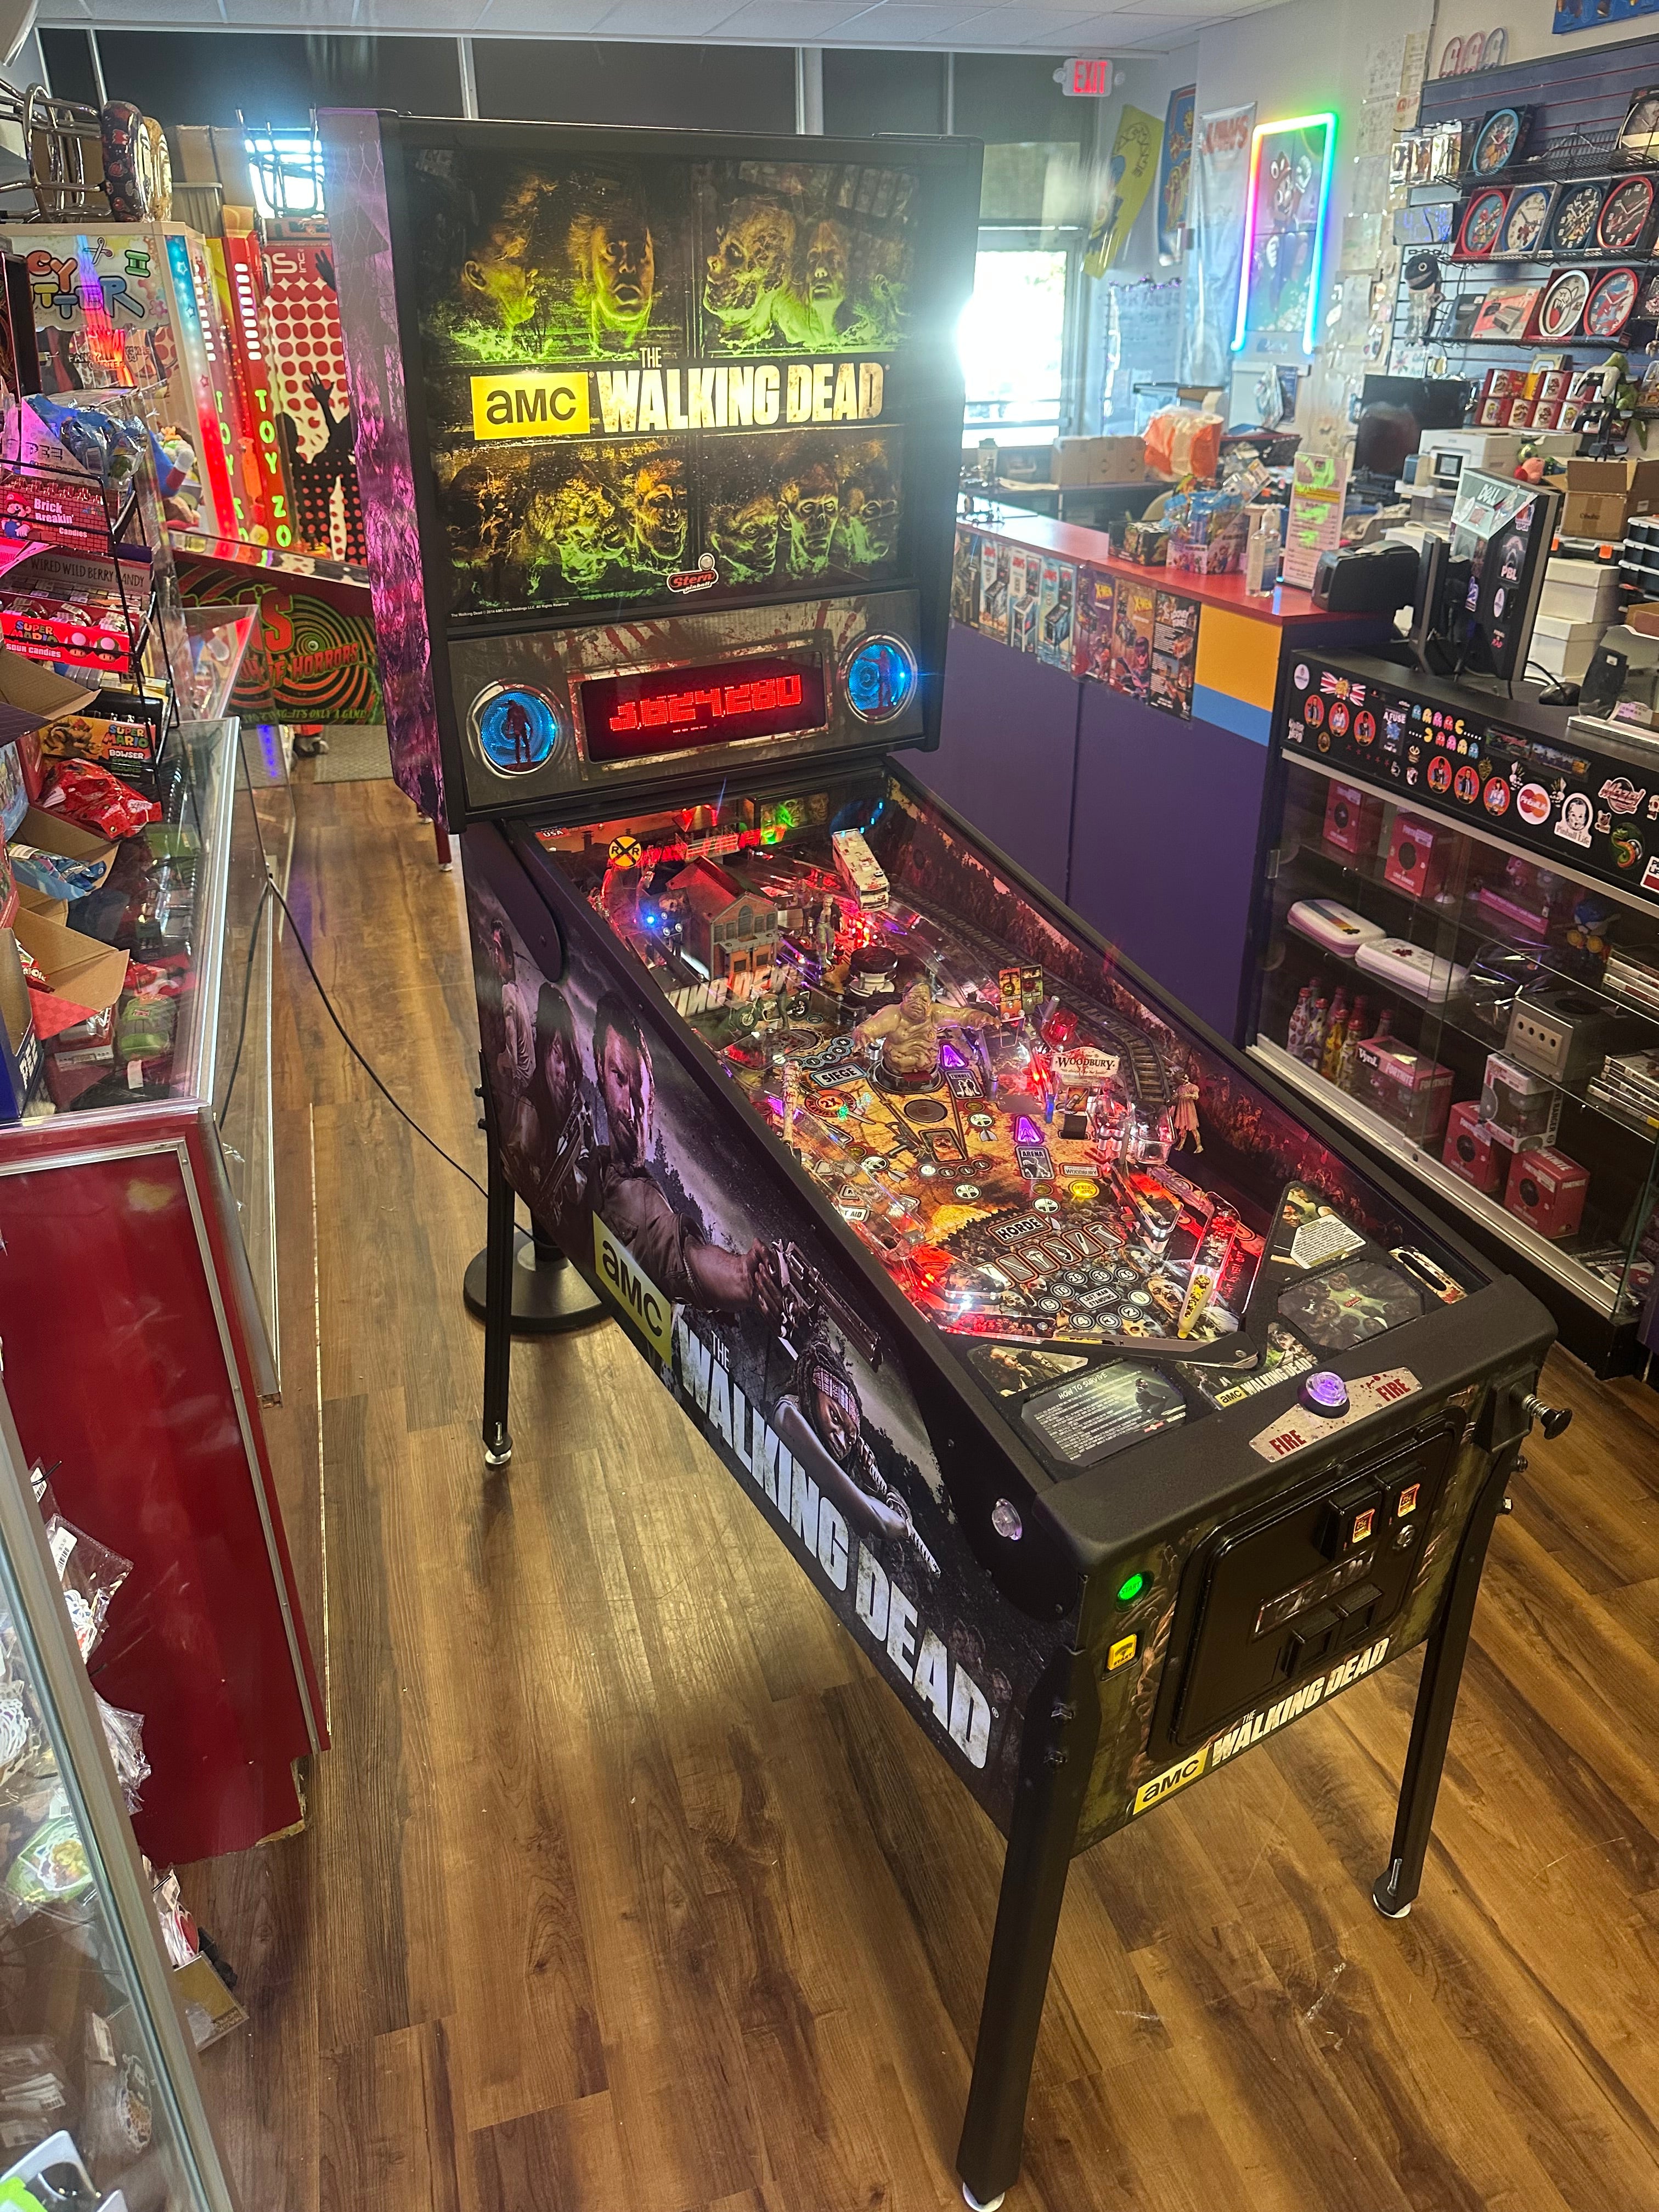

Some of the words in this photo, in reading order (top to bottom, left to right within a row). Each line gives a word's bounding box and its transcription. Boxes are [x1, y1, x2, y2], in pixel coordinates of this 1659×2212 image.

[1074, 60, 1108, 94] EXIT
[639, 346, 662, 369] THE
[596, 364, 781, 434] WALKING
[786, 362, 884, 424] DEAD
[1476, 483, 1500, 506] DELL
[34, 498, 63, 514] Brick
[35, 512, 74, 524] Breakin'
[59, 527, 88, 538] Candies
[31, 557, 60, 573] WIRED
[63, 563, 86, 577] WILD
[88, 568, 114, 582] BERRY
[1501, 565, 1517, 581] PBL
[673, 573, 712, 588] Stern
[685, 582, 710, 591] pinball
[16, 620, 53, 635] SUPER
[10, 629, 58, 647] MARIO
[6, 643, 27, 653] SOUR
[291, 642, 360, 680] HORRORS
[1389, 712, 1406, 725] FUSE
[109, 724, 145, 737] SUPER
[102, 733, 149, 748] MARIO
[109, 749, 145, 760] BOWSER
[1556, 825, 1577, 840] Pinball
[1578, 831, 1590, 845] Life
[611, 846, 619, 855] R
[632, 847, 640, 855] R
[1058, 1057, 1113, 1070] WOODBURY
[821, 1068, 857, 1083] SIEGE
[1386, 1063, 1414, 1087] FORTNITE
[820, 1098, 842, 1108] 2X
[995, 1217, 1043, 1241] HORDE
[1068, 1273, 1083, 1283] 20
[1094, 1271, 1108, 1280] 30
[1120, 1269, 1133, 1279] 40
[1054, 1286, 1070, 1295] 10
[1082, 1293, 1096, 1302] LAST
[1096, 1289, 1109, 1297] MAN
[1046, 1300, 1056, 1309] 5
[1089, 1294, 1115, 1307] STANDING
[1123, 1307, 1138, 1317] 2
[1077, 1316, 1089, 1326] 4
[1103, 1316, 1115, 1325] 3
[712, 1330, 730, 1372] THE
[1240, 1365, 1289, 1396] WALKING
[1287, 1357, 1313, 1380] DEAD
[1058, 1388, 1074, 1400] HOW
[1074, 1383, 1083, 1391] TO
[1082, 1372, 1108, 1389] SURVIVE
[1376, 1378, 1412, 1402] FIRE
[1268, 1429, 1307, 1456] FIRE
[678, 1314, 849, 1592] WALKING
[855, 1541, 991, 1770] DEAD
[1121, 1580, 1141, 1595] START
[1114, 1652, 1133, 1666] START
[1211, 1677, 1326, 1767] WALKING
[1324, 1637, 1390, 1698] DEAD
[1243, 1709, 1256, 1724] THE
